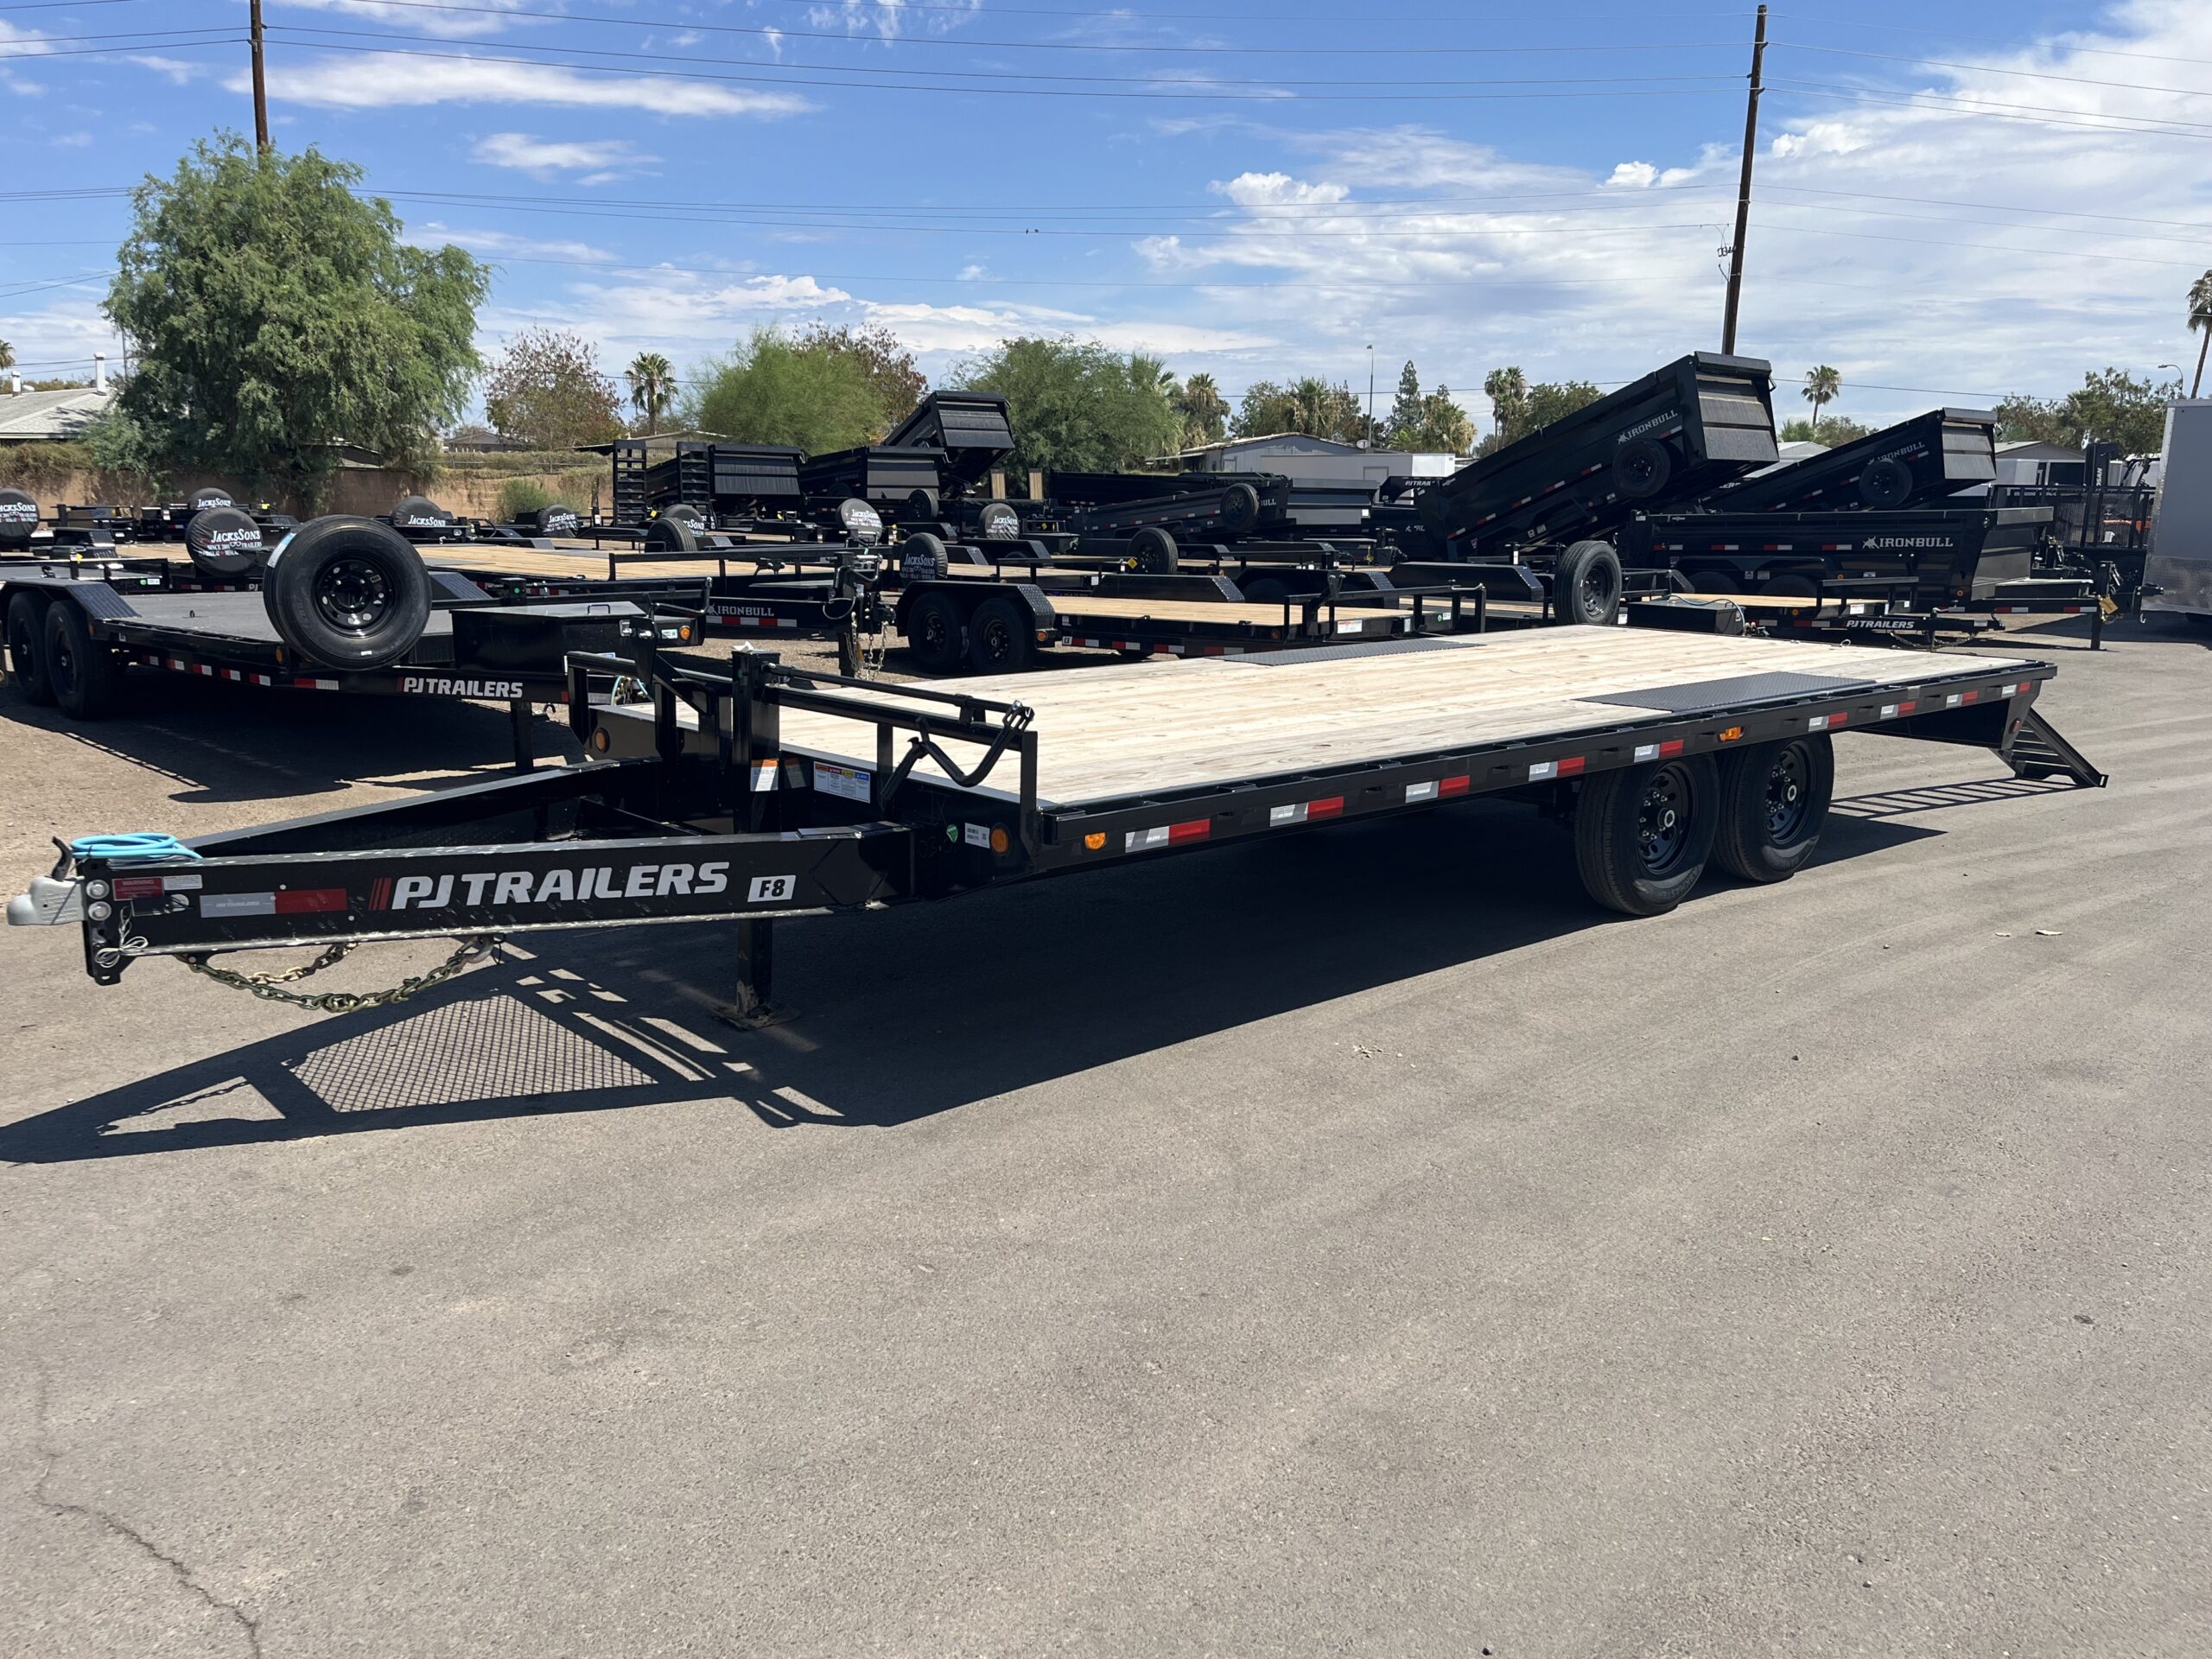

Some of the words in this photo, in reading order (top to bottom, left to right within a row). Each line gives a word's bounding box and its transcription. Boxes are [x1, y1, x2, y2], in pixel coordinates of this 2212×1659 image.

[1627, 410, 1678, 438] IRONBULL
[0, 502, 36, 512] ACKSSONS
[1879, 537, 1953, 547] IRONBULL
[717, 605, 774, 616] IRONBULL
[1860, 620, 1915, 629] TRAILERS
[404, 677, 424, 693] PJ
[426, 678, 523, 698] TRAILERS
[391, 875, 454, 910] PJ
[461, 861, 730, 906] TRAILERS
[759, 879, 785, 898] F8
